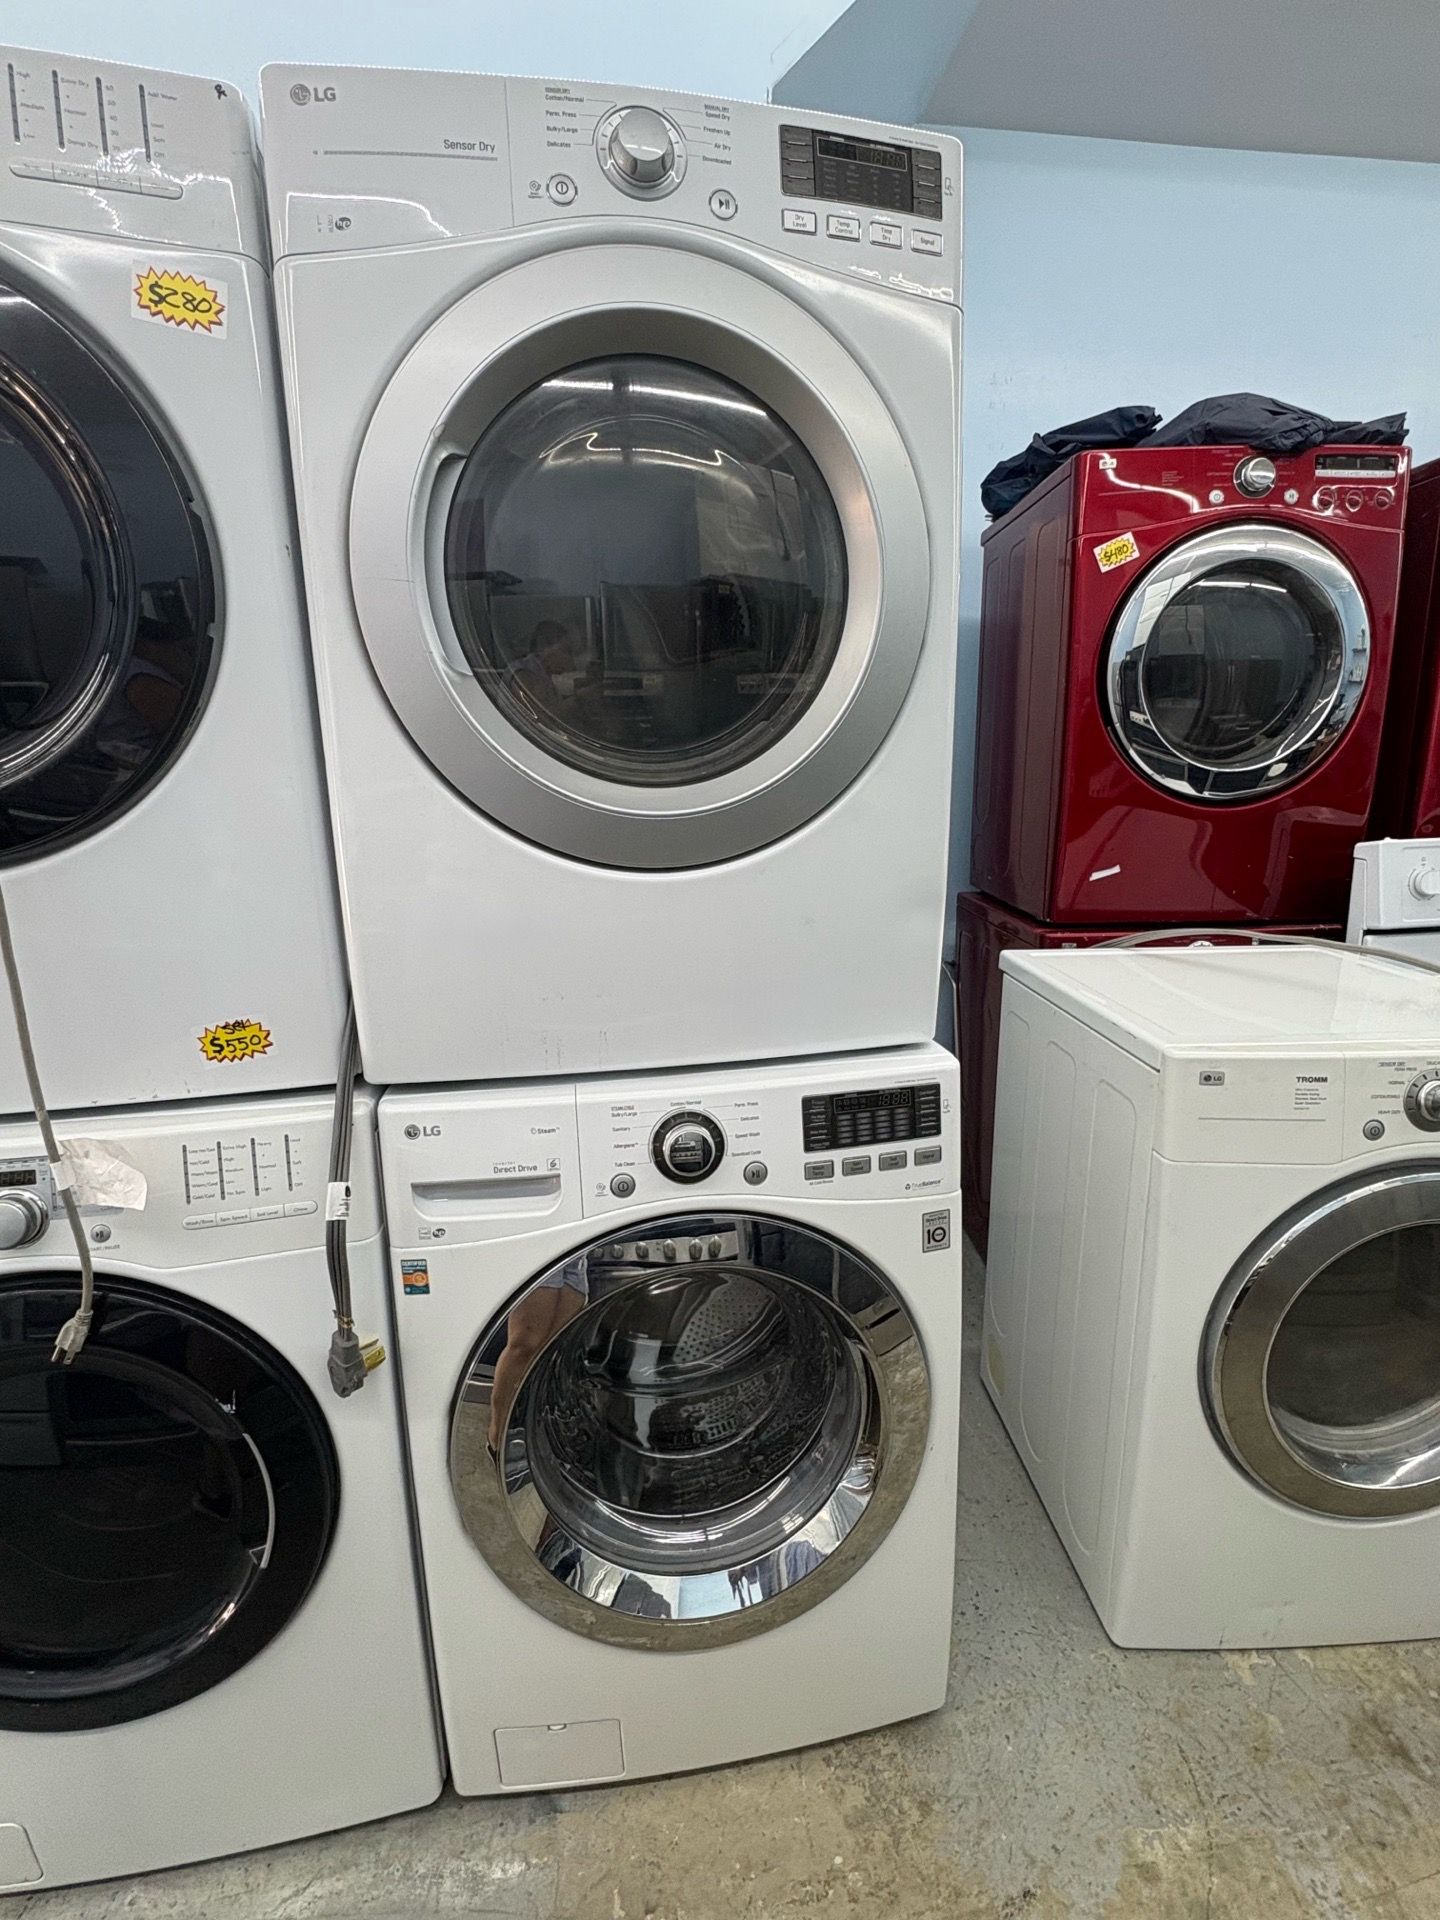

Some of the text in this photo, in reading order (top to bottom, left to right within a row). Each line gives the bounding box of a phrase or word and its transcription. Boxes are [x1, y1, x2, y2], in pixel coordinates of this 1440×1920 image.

[313, 86, 337, 102] LG
[545, 94, 584, 102] Cotton/Normal
[546, 126, 578, 134] Bulky/Large
[443, 139, 496, 154] Sensor Dry
[209, 1035, 262, 1056] $550
[1296, 1076, 1328, 1084] TROMM
[422, 1125, 442, 1137] LG
[612, 1126, 631, 1134] Sanitary
[493, 1164, 538, 1175] Direct Drive
[926, 1226, 947, 1245] 10
